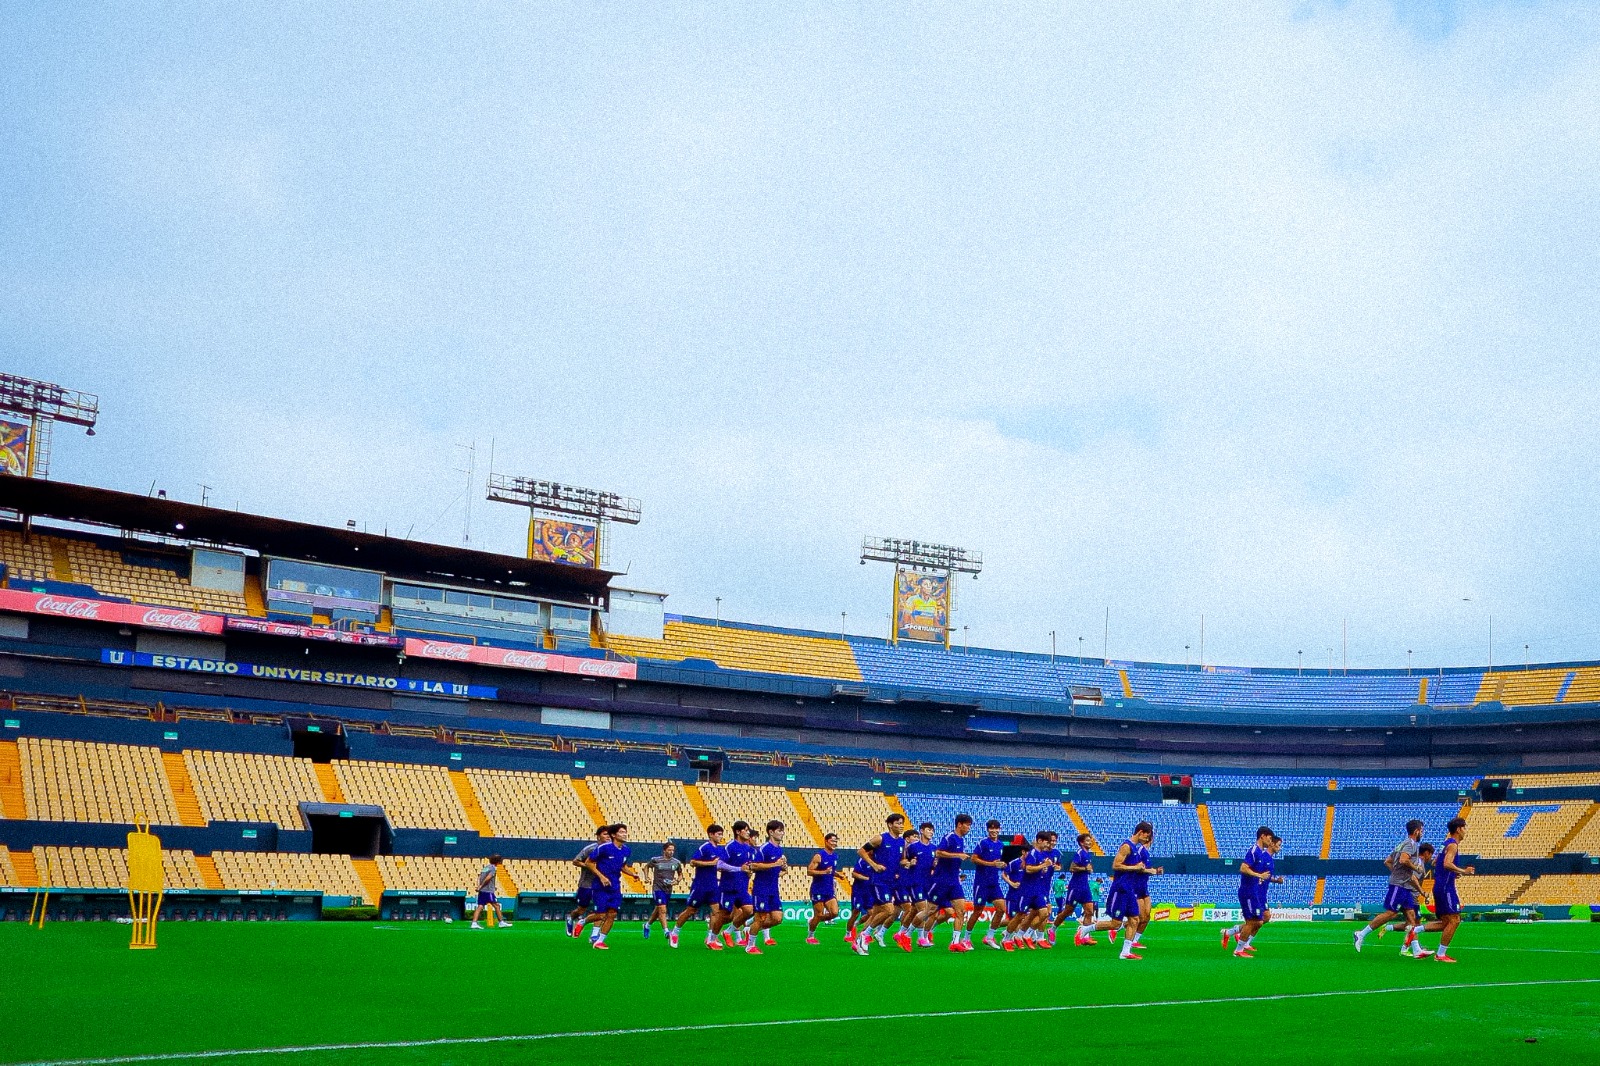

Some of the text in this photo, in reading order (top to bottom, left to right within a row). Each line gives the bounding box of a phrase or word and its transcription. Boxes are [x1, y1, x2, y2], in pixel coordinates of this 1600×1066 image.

[35, 595, 98, 618] Coca-Cola
[142, 609, 203, 631] Coca-Cola
[422, 642, 470, 660] Coca-Cola
[503, 651, 547, 669] Coca-Cola
[152, 655, 398, 689] ESTADIO UNIVERSITARIO
[578, 660, 620, 677] Coca-Cola
[423, 681, 444, 693] LA
[1312, 907, 1330, 916] CUP
